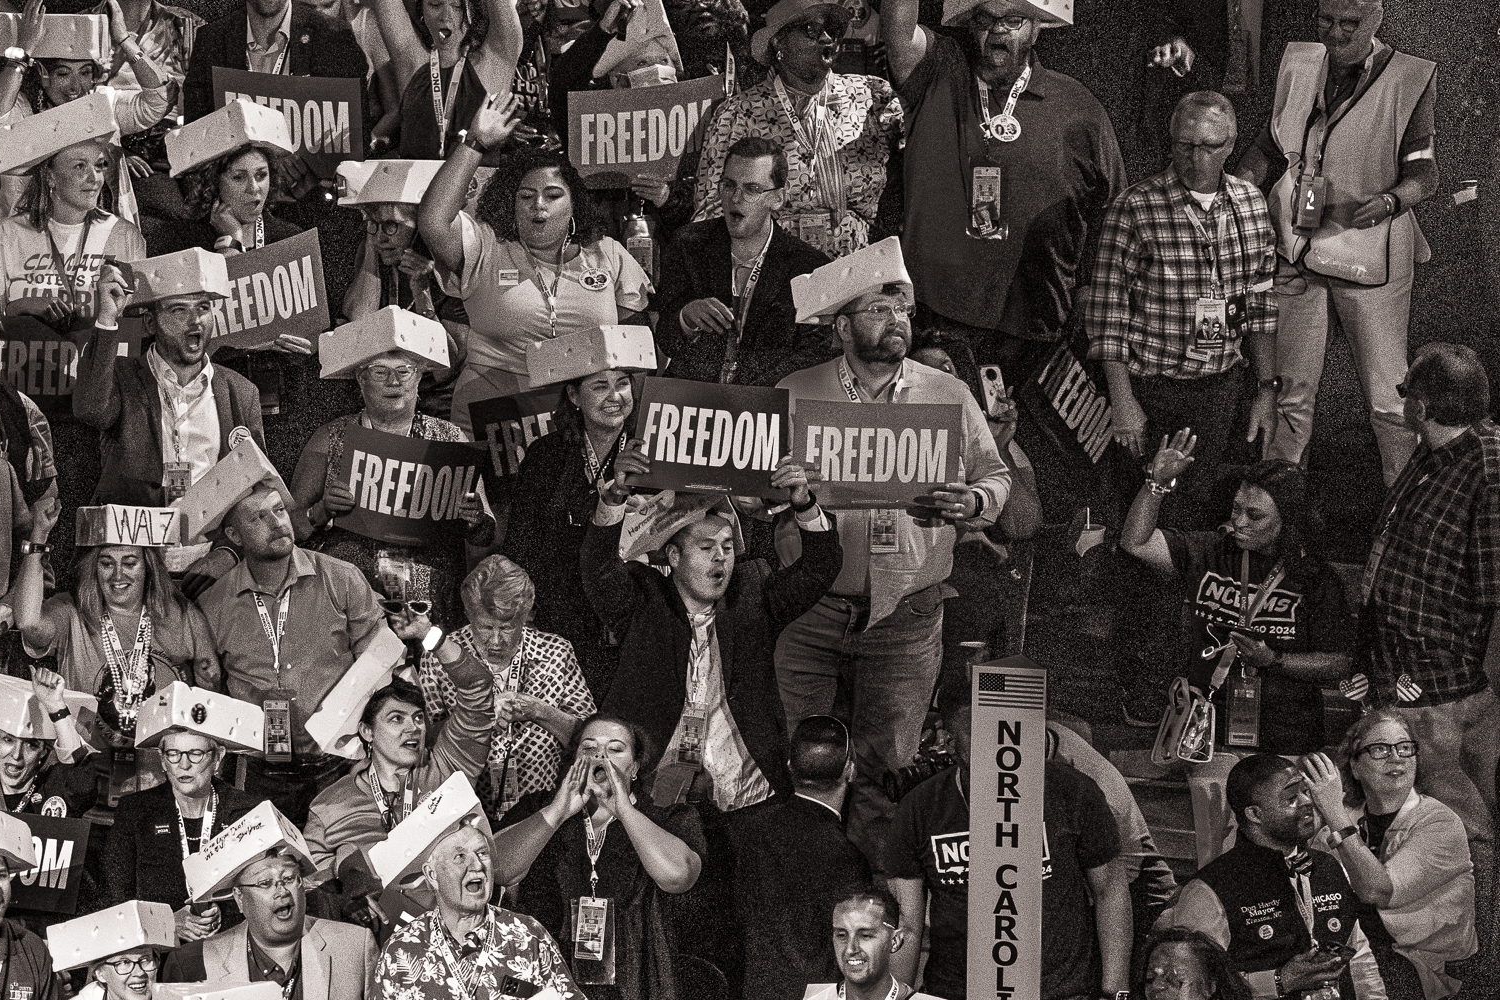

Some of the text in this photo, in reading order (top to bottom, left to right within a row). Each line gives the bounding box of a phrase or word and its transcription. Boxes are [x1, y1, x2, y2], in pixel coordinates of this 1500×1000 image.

[209, 255, 318, 339] REEDOM
[641, 402, 780, 472] FREEDOM
[805, 425, 949, 483] FREEDOM
[348, 449, 477, 521] FREEDOM
[111, 506, 175, 546] WALZ
[1270, 625, 1296, 637] 2024
[510, 658, 520, 679] DNC
[994, 719, 1022, 847] NORTH
[1249, 906, 1276, 918] Mayor
[1311, 893, 1342, 904] HICAGO
